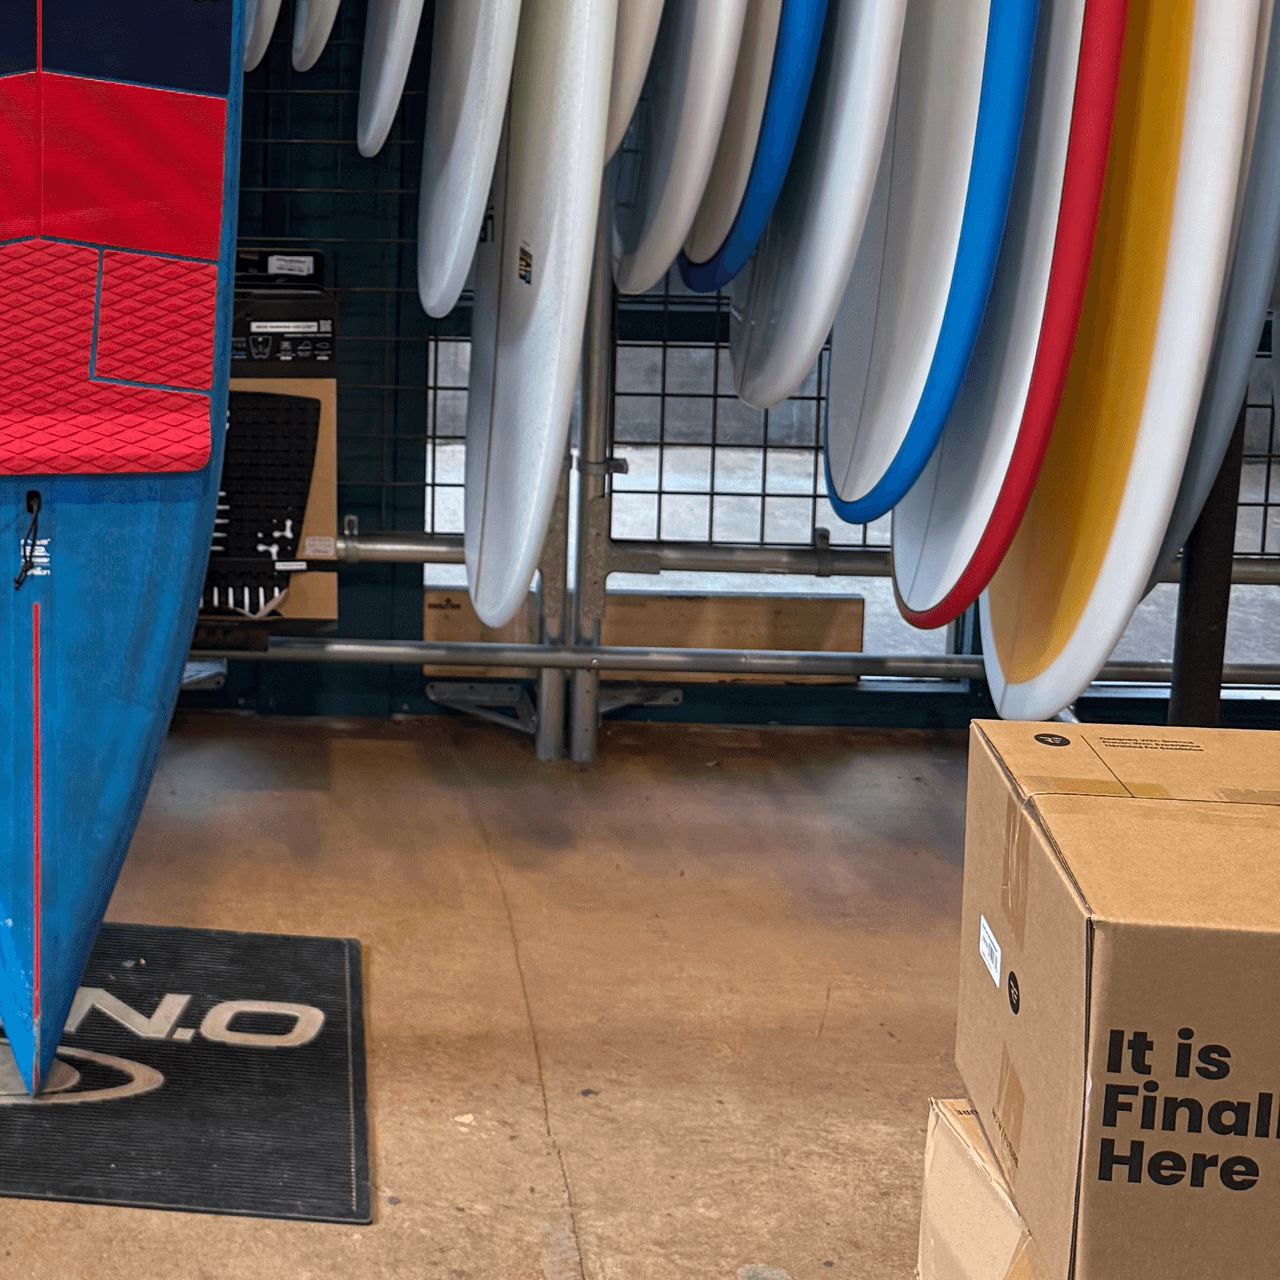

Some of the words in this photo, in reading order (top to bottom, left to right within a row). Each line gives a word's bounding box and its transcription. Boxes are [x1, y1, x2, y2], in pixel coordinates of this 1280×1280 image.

[1106, 1029, 1154, 1075] It
[1175, 1027, 1232, 1080] is
[1102, 1080, 1280, 1139] Final
[1098, 1137, 1260, 1191] Here
